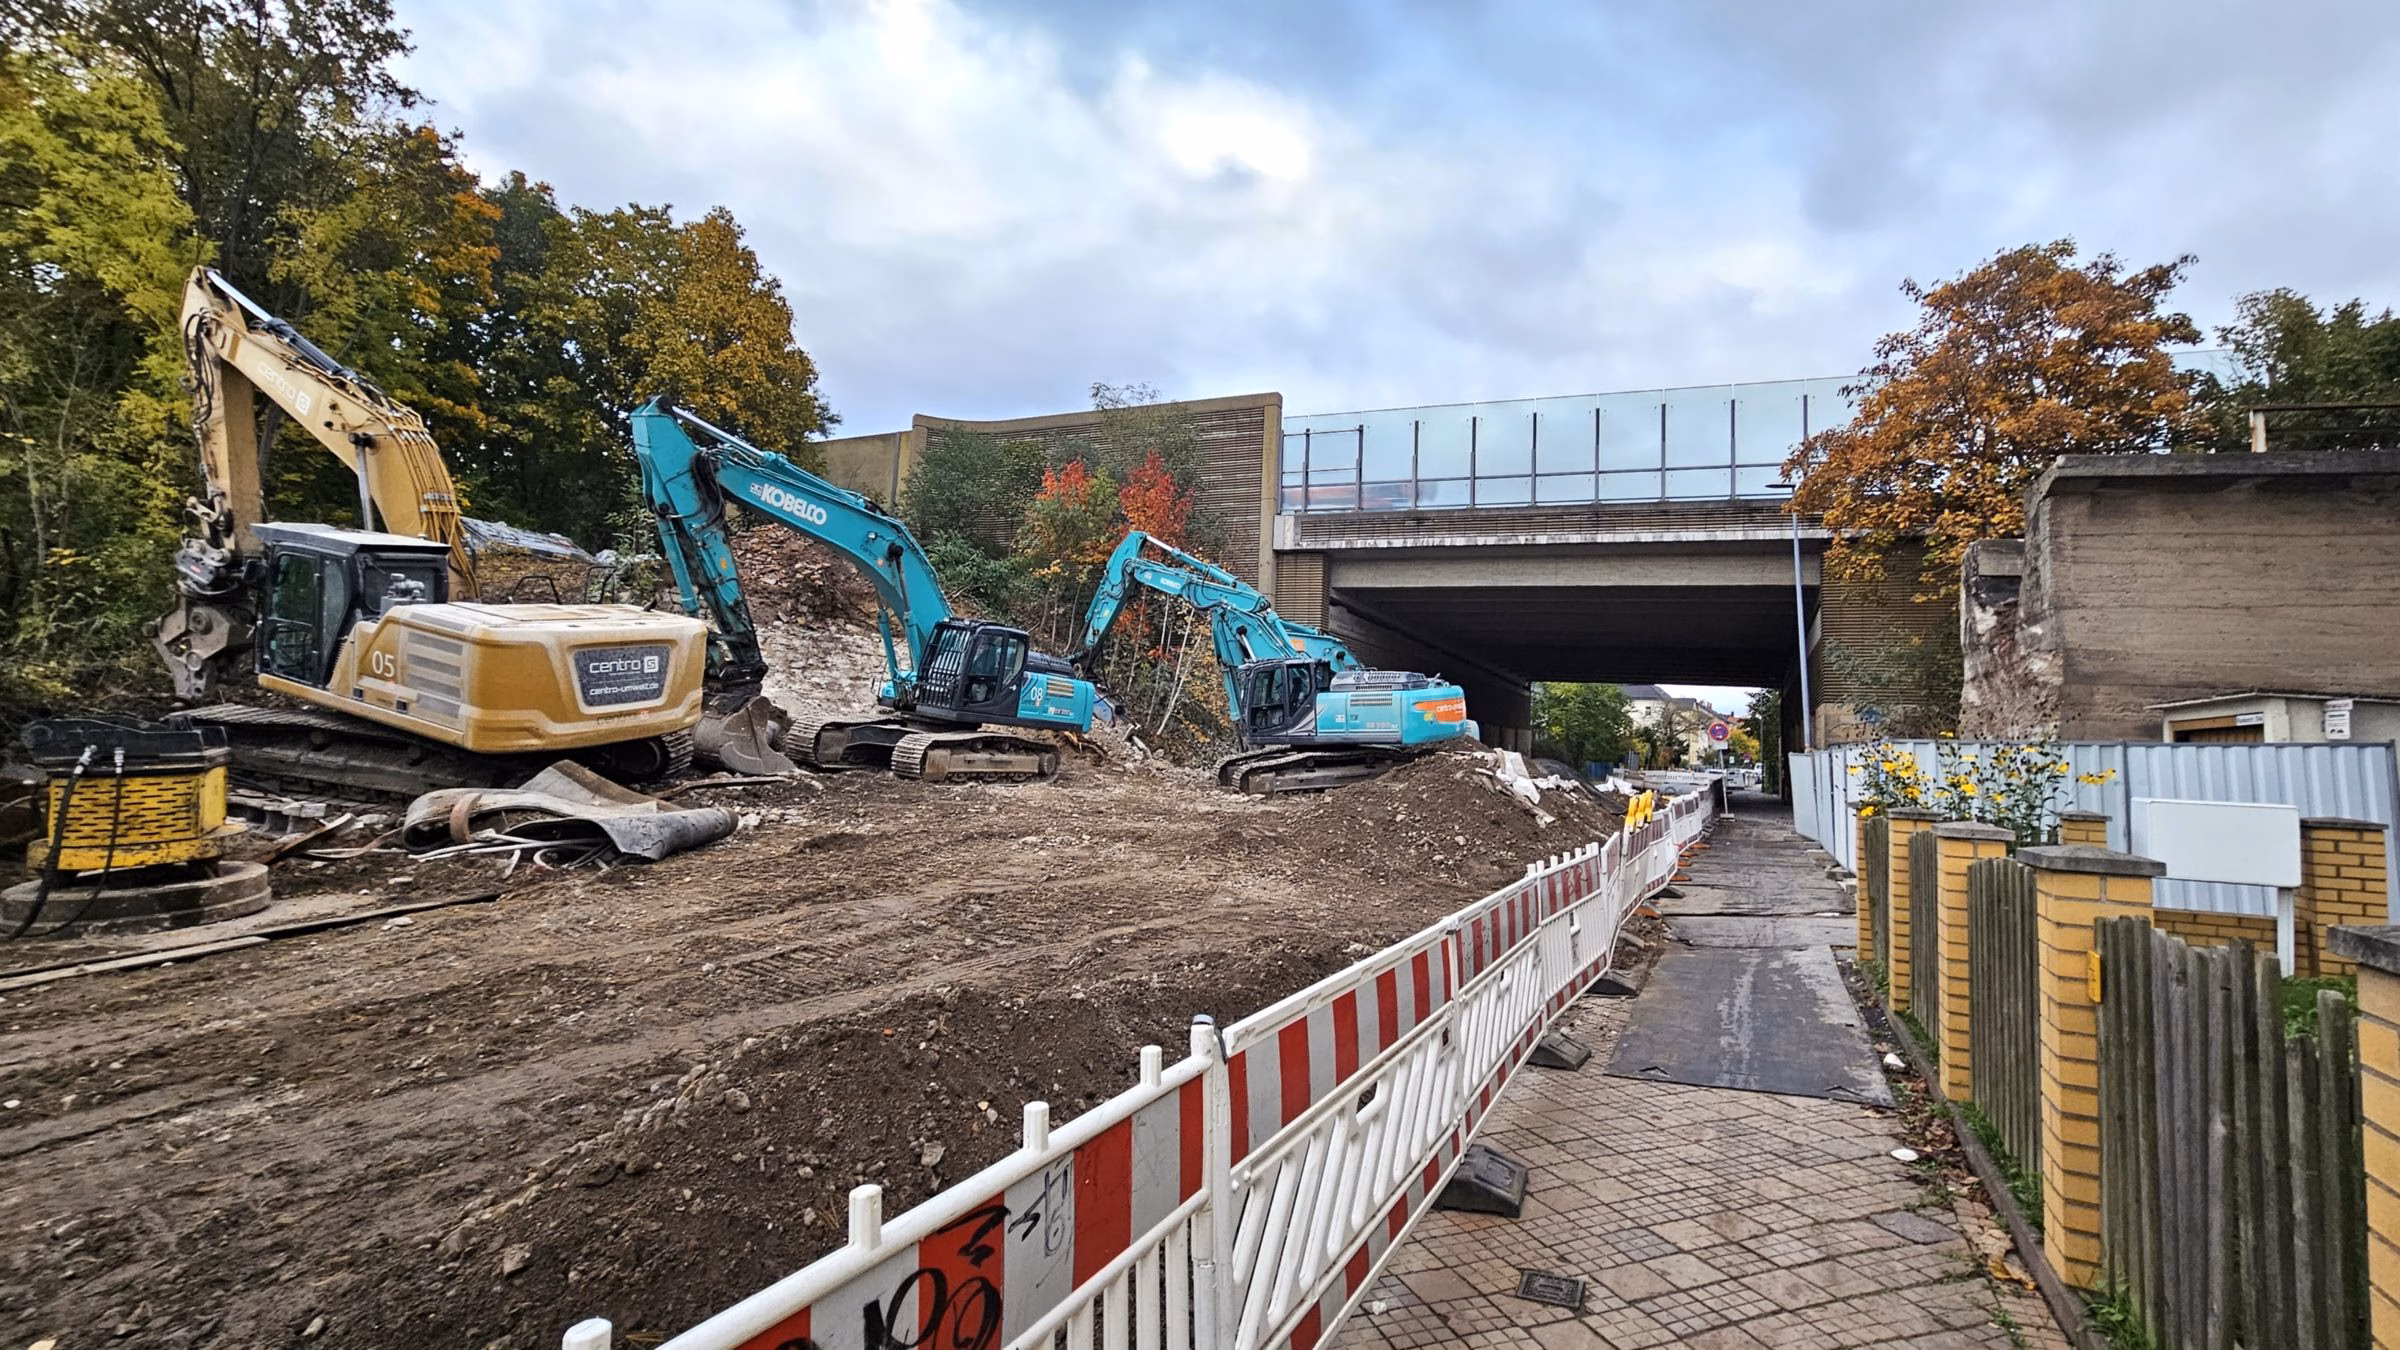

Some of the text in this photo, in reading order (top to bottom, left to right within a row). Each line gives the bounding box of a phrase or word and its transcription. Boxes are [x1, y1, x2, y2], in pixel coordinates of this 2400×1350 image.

[761, 483, 827, 525] KOBELCO
[372, 650, 395, 677] 05
[589, 659, 641, 673] centro
[589, 683, 659, 695] centro-umwelt.de
[1030, 686, 1043, 701] 08
